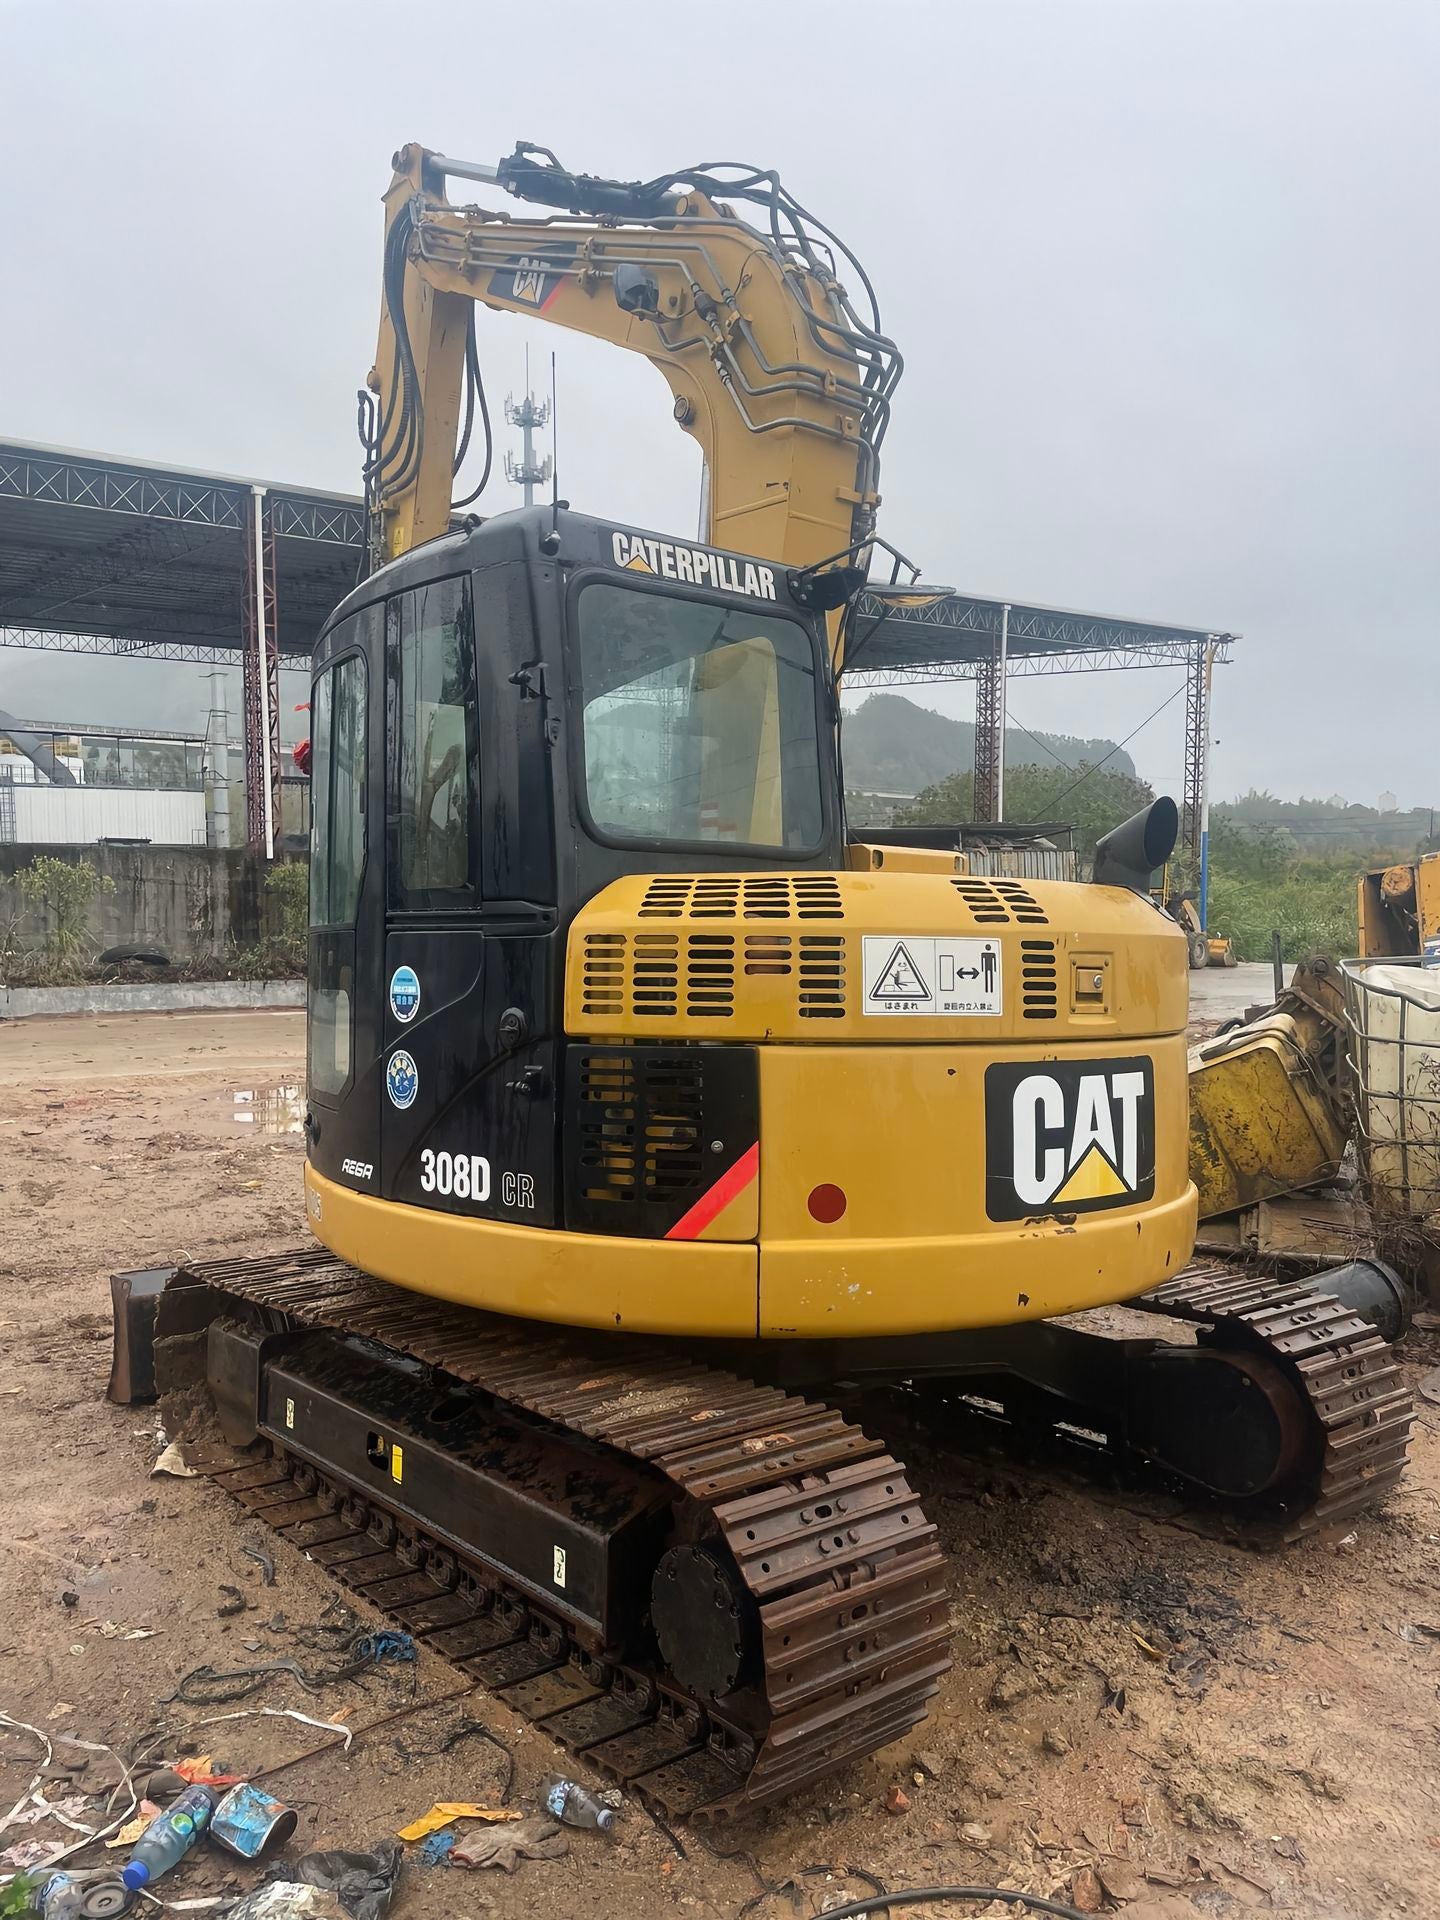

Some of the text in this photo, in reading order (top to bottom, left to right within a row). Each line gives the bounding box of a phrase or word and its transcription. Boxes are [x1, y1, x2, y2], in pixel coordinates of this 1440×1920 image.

[512, 257, 551, 304] CAT
[612, 531, 776, 600] CATERPILLAR
[884, 1002, 919, 1010] はさまれ
[1012, 1071, 1145, 1205] CAT
[420, 1148, 534, 1208] 308D CR
